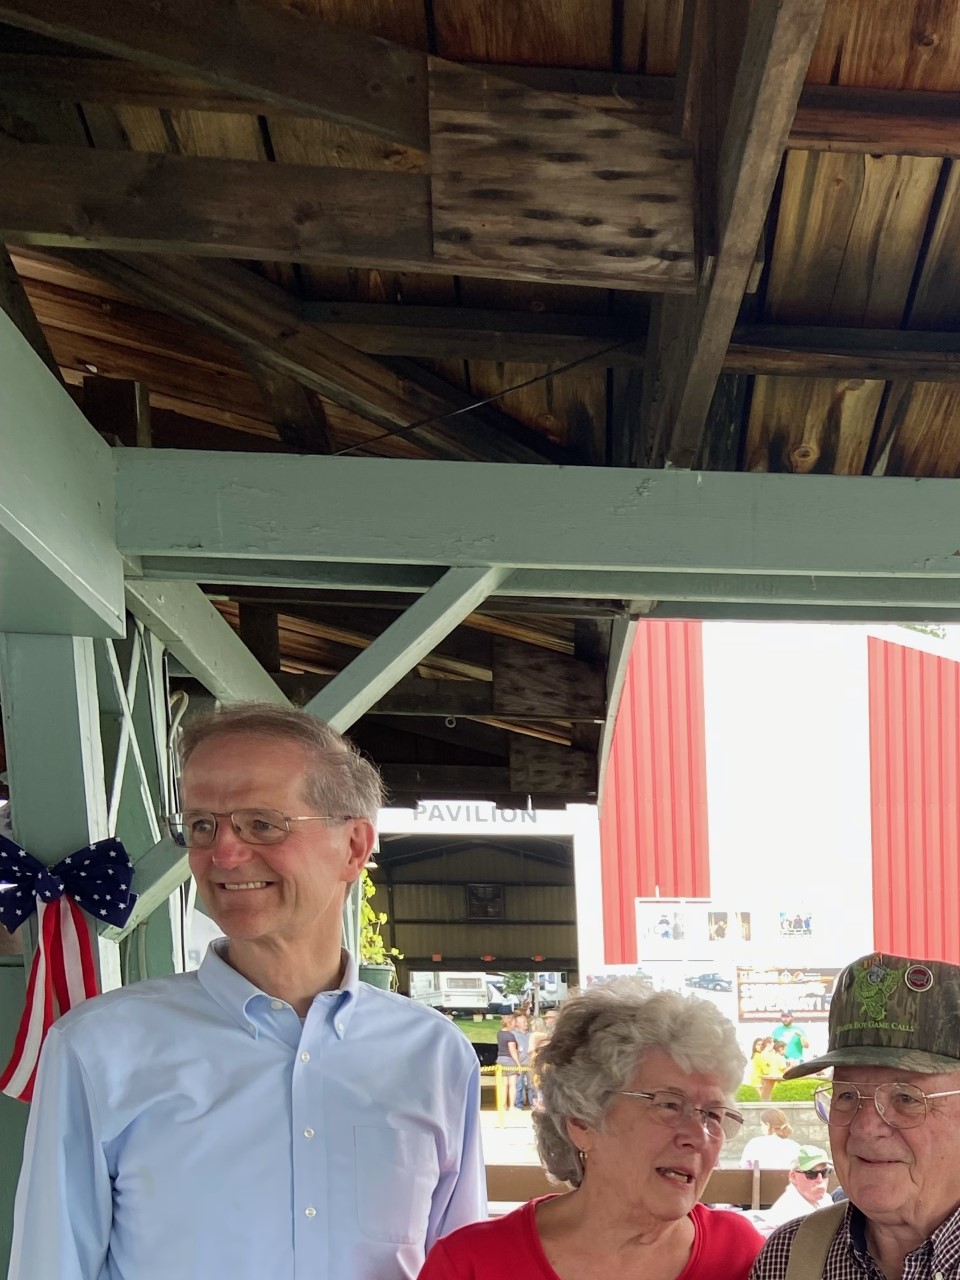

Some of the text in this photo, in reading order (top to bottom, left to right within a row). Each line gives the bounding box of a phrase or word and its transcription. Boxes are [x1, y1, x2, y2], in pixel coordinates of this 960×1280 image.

[413, 804, 537, 823] PAVILION
[868, 1020, 890, 1029] GAME
[891, 1022, 914, 1032] CALLS
